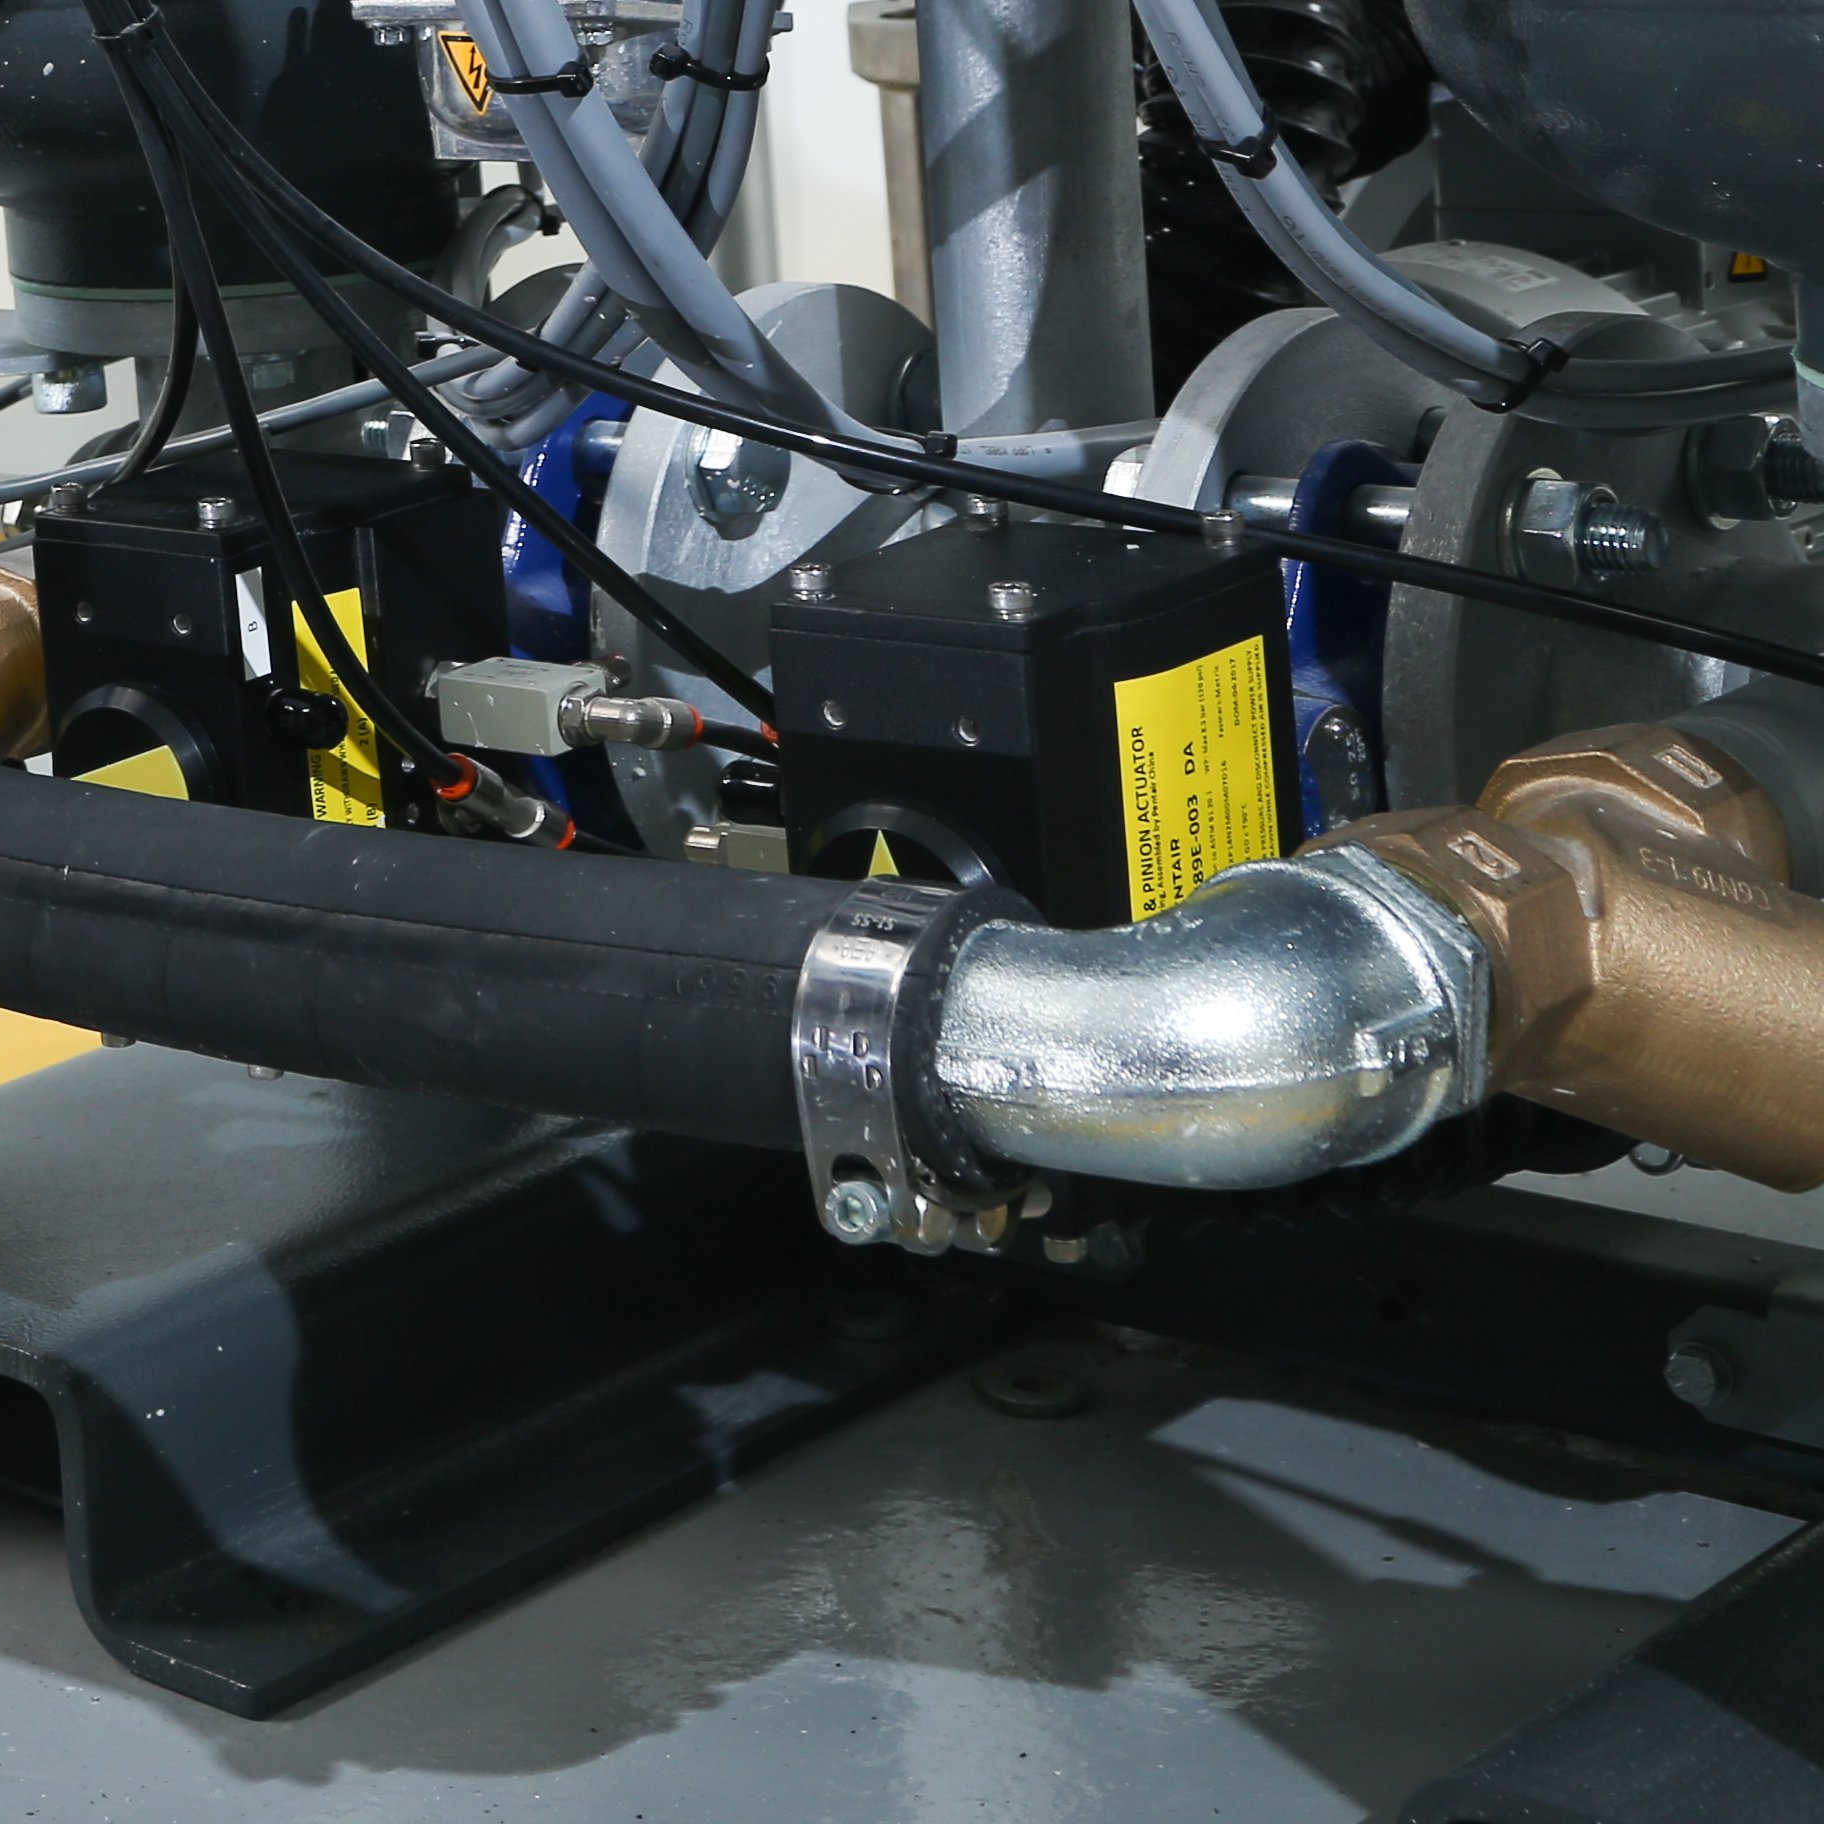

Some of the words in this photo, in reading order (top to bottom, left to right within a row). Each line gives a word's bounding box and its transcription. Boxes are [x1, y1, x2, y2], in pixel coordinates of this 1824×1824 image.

[247, 621, 258, 633] B
[1248, 685, 1257, 721] POWER
[1257, 691, 1263, 702] IS
[356, 717, 369, 734] (A)
[359, 738, 370, 747] 2
[1147, 750, 1156, 780] China
[1182, 740, 1195, 775] DA
[1251, 721, 1261, 781] DISCONNECT
[1259, 722, 1270, 789] COMPRESSED
[310, 754, 327, 818] WARNING
[340, 762, 353, 816] WITHDRAWN
[1131, 725, 1149, 825] ACTUATOR
[1255, 781, 1263, 803] AND
[366, 803, 378, 821] (B)
[1148, 780, 1158, 817] Pentair
[1265, 791, 1273, 823] WHILE
[1151, 818, 1161, 832] by
[1186, 793, 1203, 889] 89E-003
[1207, 823, 1216, 849] ASTM
[1257, 805, 1266, 850] PRESSURE
[1138, 827, 1154, 894] PINION
[1152, 833, 1163, 890] Assembled
[1169, 836, 1184, 905] NTAIR
[1143, 897, 1156, 914] &
